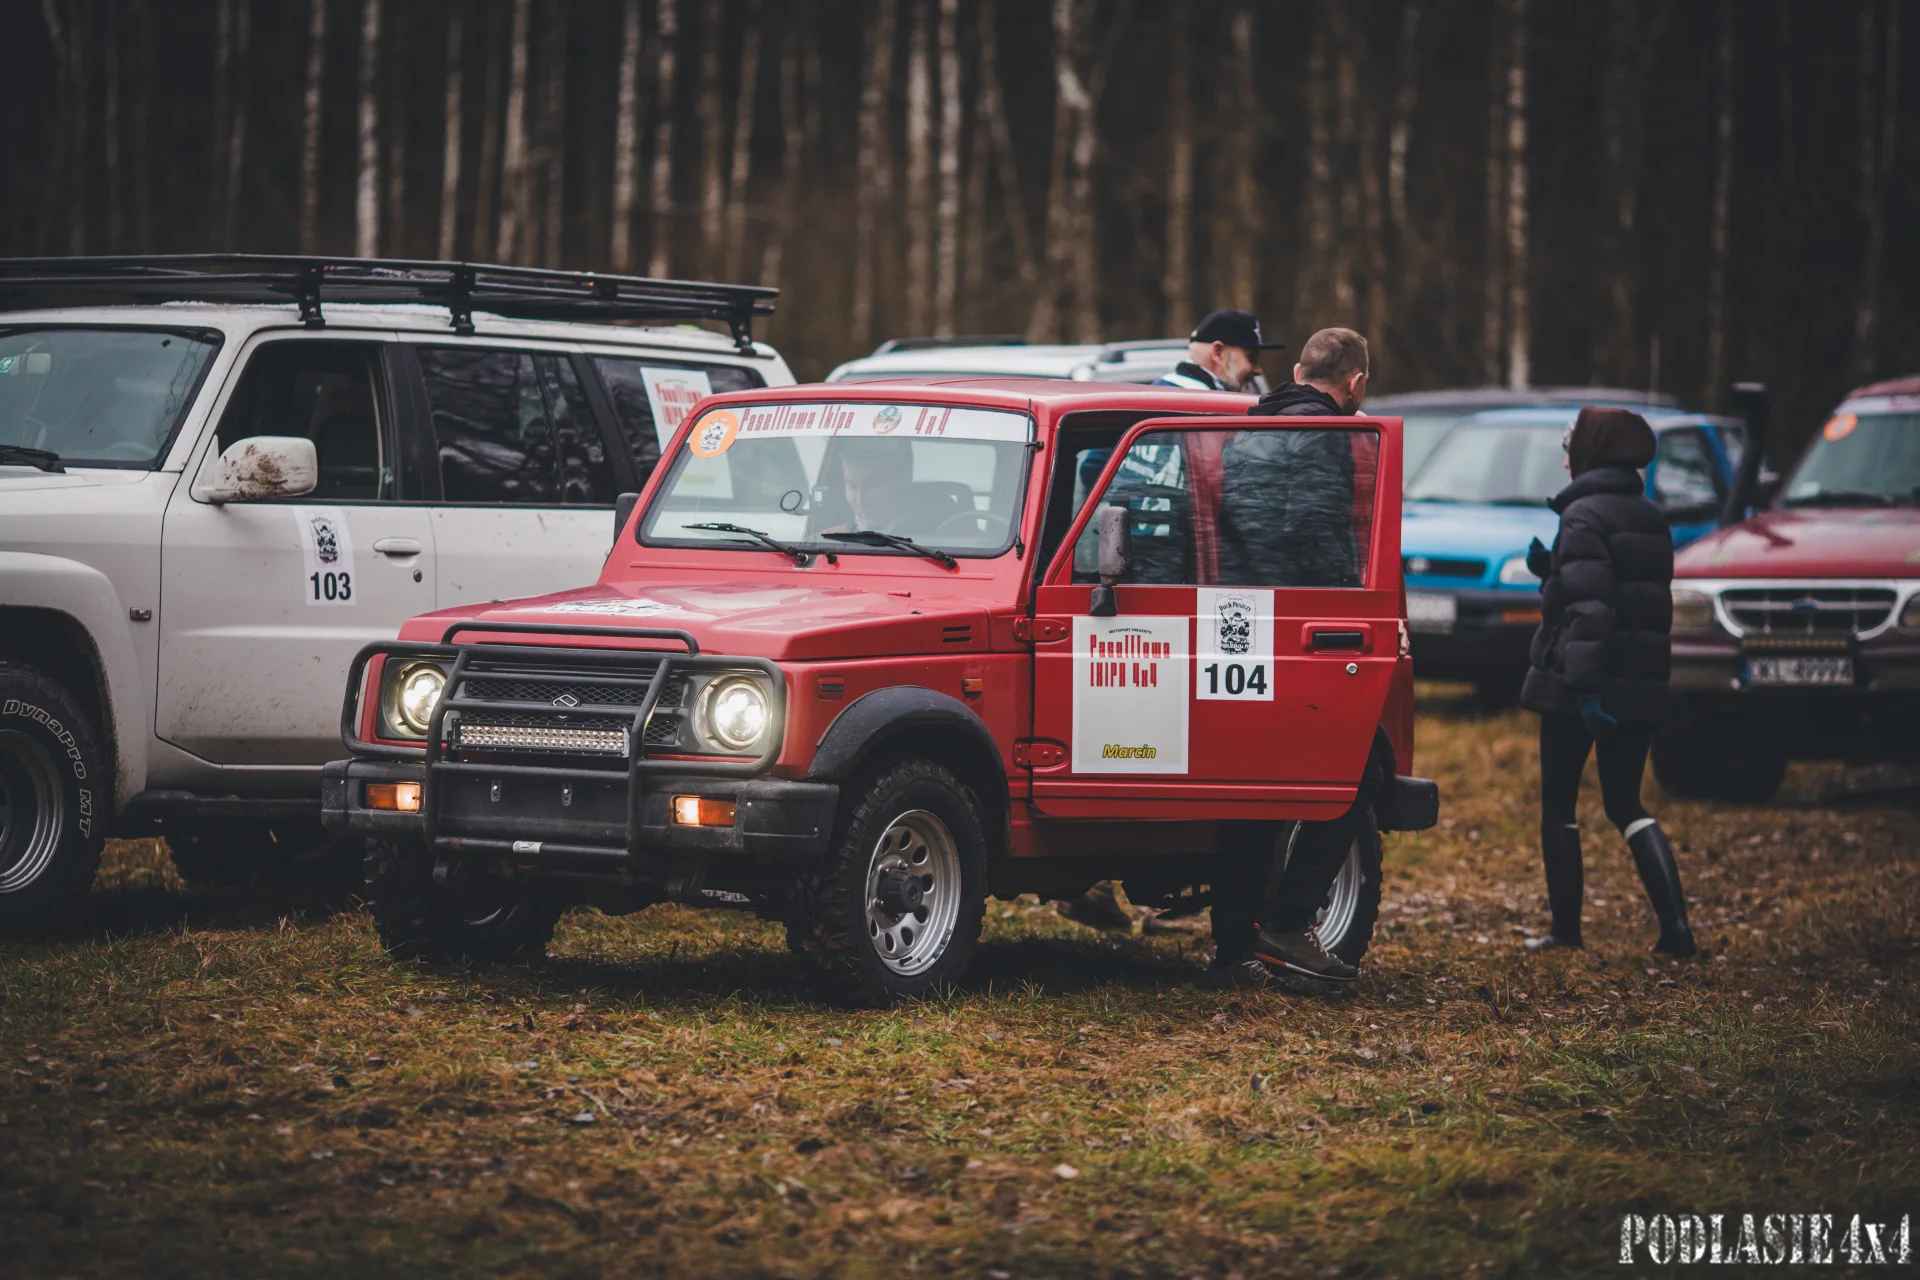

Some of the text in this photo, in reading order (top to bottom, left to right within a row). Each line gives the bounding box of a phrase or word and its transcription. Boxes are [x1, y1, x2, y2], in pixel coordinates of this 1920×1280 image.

[914, 407, 952, 435] 4x4
[310, 571, 352, 601] 103
[1132, 662, 1157, 688] 4x4
[1204, 662, 1268, 696] 104
[1102, 743, 1156, 759] Marcin
[78, 788, 92, 839] MT
